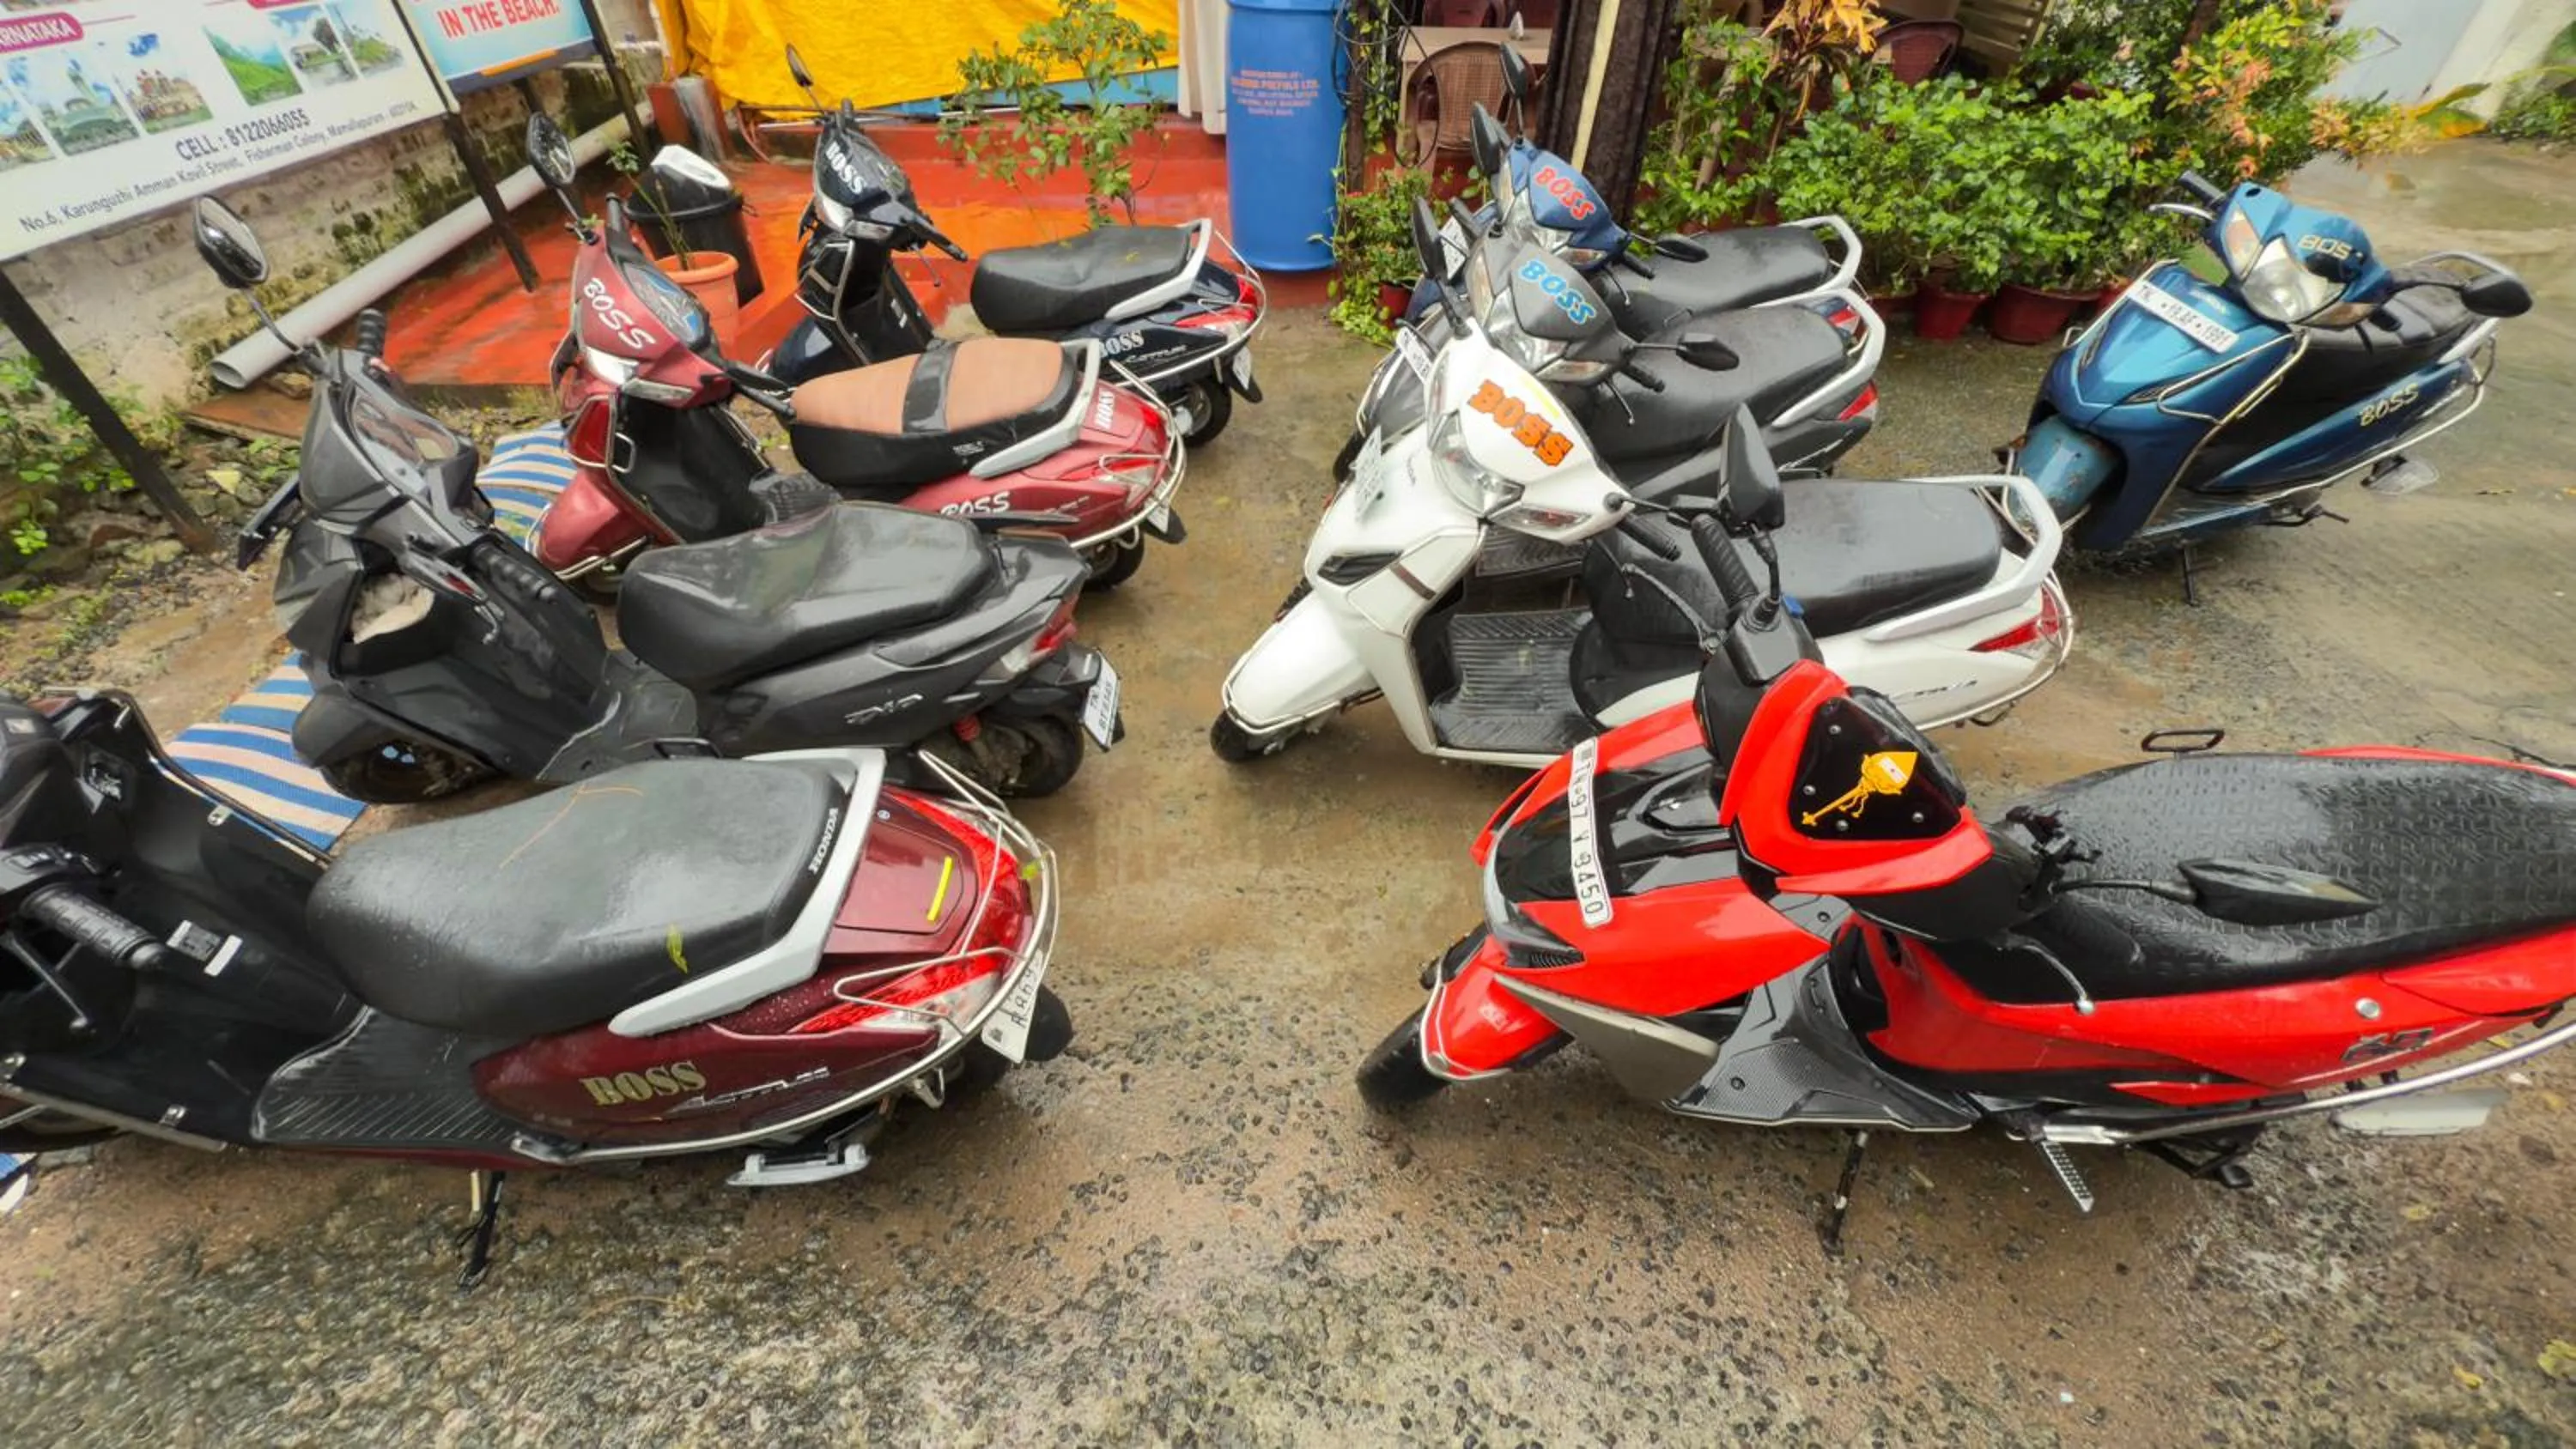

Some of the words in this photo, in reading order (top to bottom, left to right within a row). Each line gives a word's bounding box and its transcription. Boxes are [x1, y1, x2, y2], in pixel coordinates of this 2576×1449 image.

[0, 17, 78, 46] RNATAKA
[436, 8, 465, 39] IN
[462, 2, 503, 33] THE
[175, 135, 220, 161] CELL
[224, 107, 311, 147] 8122066055
[825, 141, 868, 195] BOSS
[1534, 165, 1596, 221] BOSS
[19, 211, 64, 233] No.6,
[2298, 234, 2364, 260] BOS
[584, 277, 656, 349] BOSS
[1517, 259, 1596, 325] BOSS
[1466, 379, 1574, 468] BOSS
[2360, 382, 2419, 427] BOSS
[1571, 793, 1589, 817] 97
[808, 808, 839, 875] HONDA
[579, 1060, 707, 1106] BOSS
